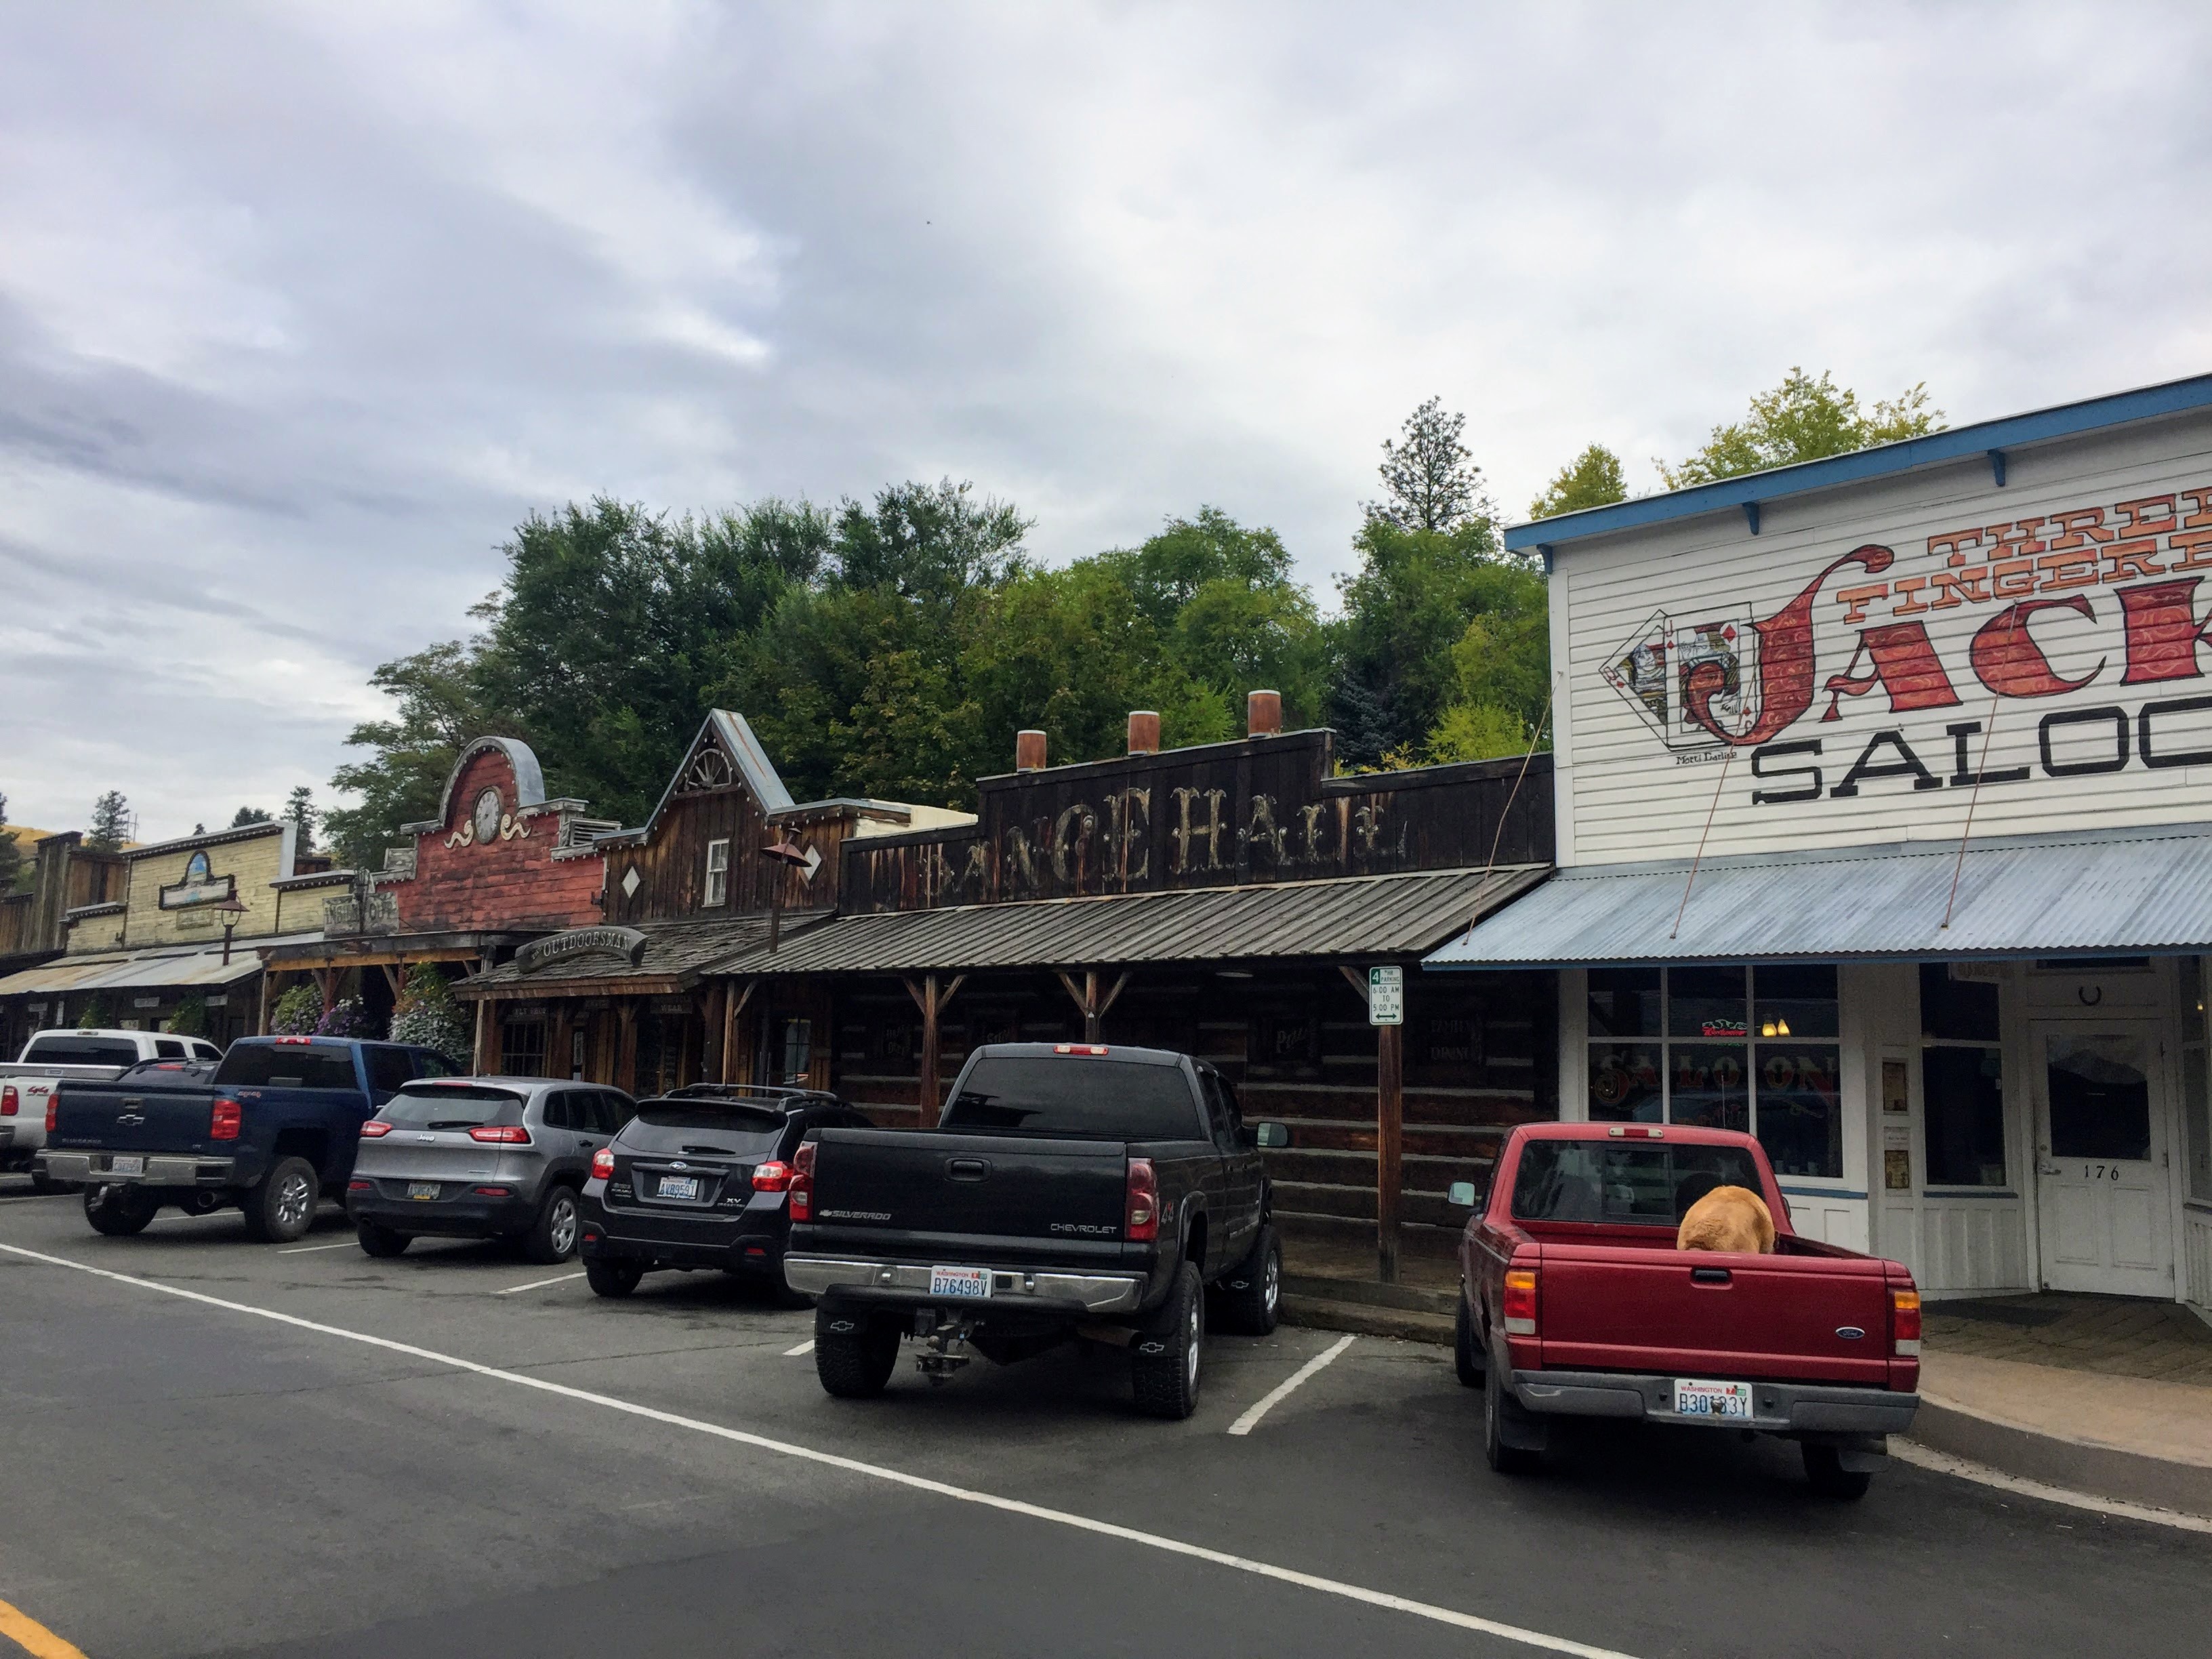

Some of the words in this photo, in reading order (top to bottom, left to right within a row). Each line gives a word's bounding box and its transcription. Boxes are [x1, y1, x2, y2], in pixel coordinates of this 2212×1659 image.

[543, 931, 630, 957] OUTDOORSMAN
[1372, 971, 1379, 982] 4
[417, 1134, 435, 1142] Jeep
[2085, 1165, 2119, 1181] 176
[832, 1210, 892, 1221] SILVERADO
[1050, 1223, 1118, 1233] CHEVROLET
[934, 1277, 987, 1296] B76498V
[1679, 1393, 1748, 1416] B303Y
